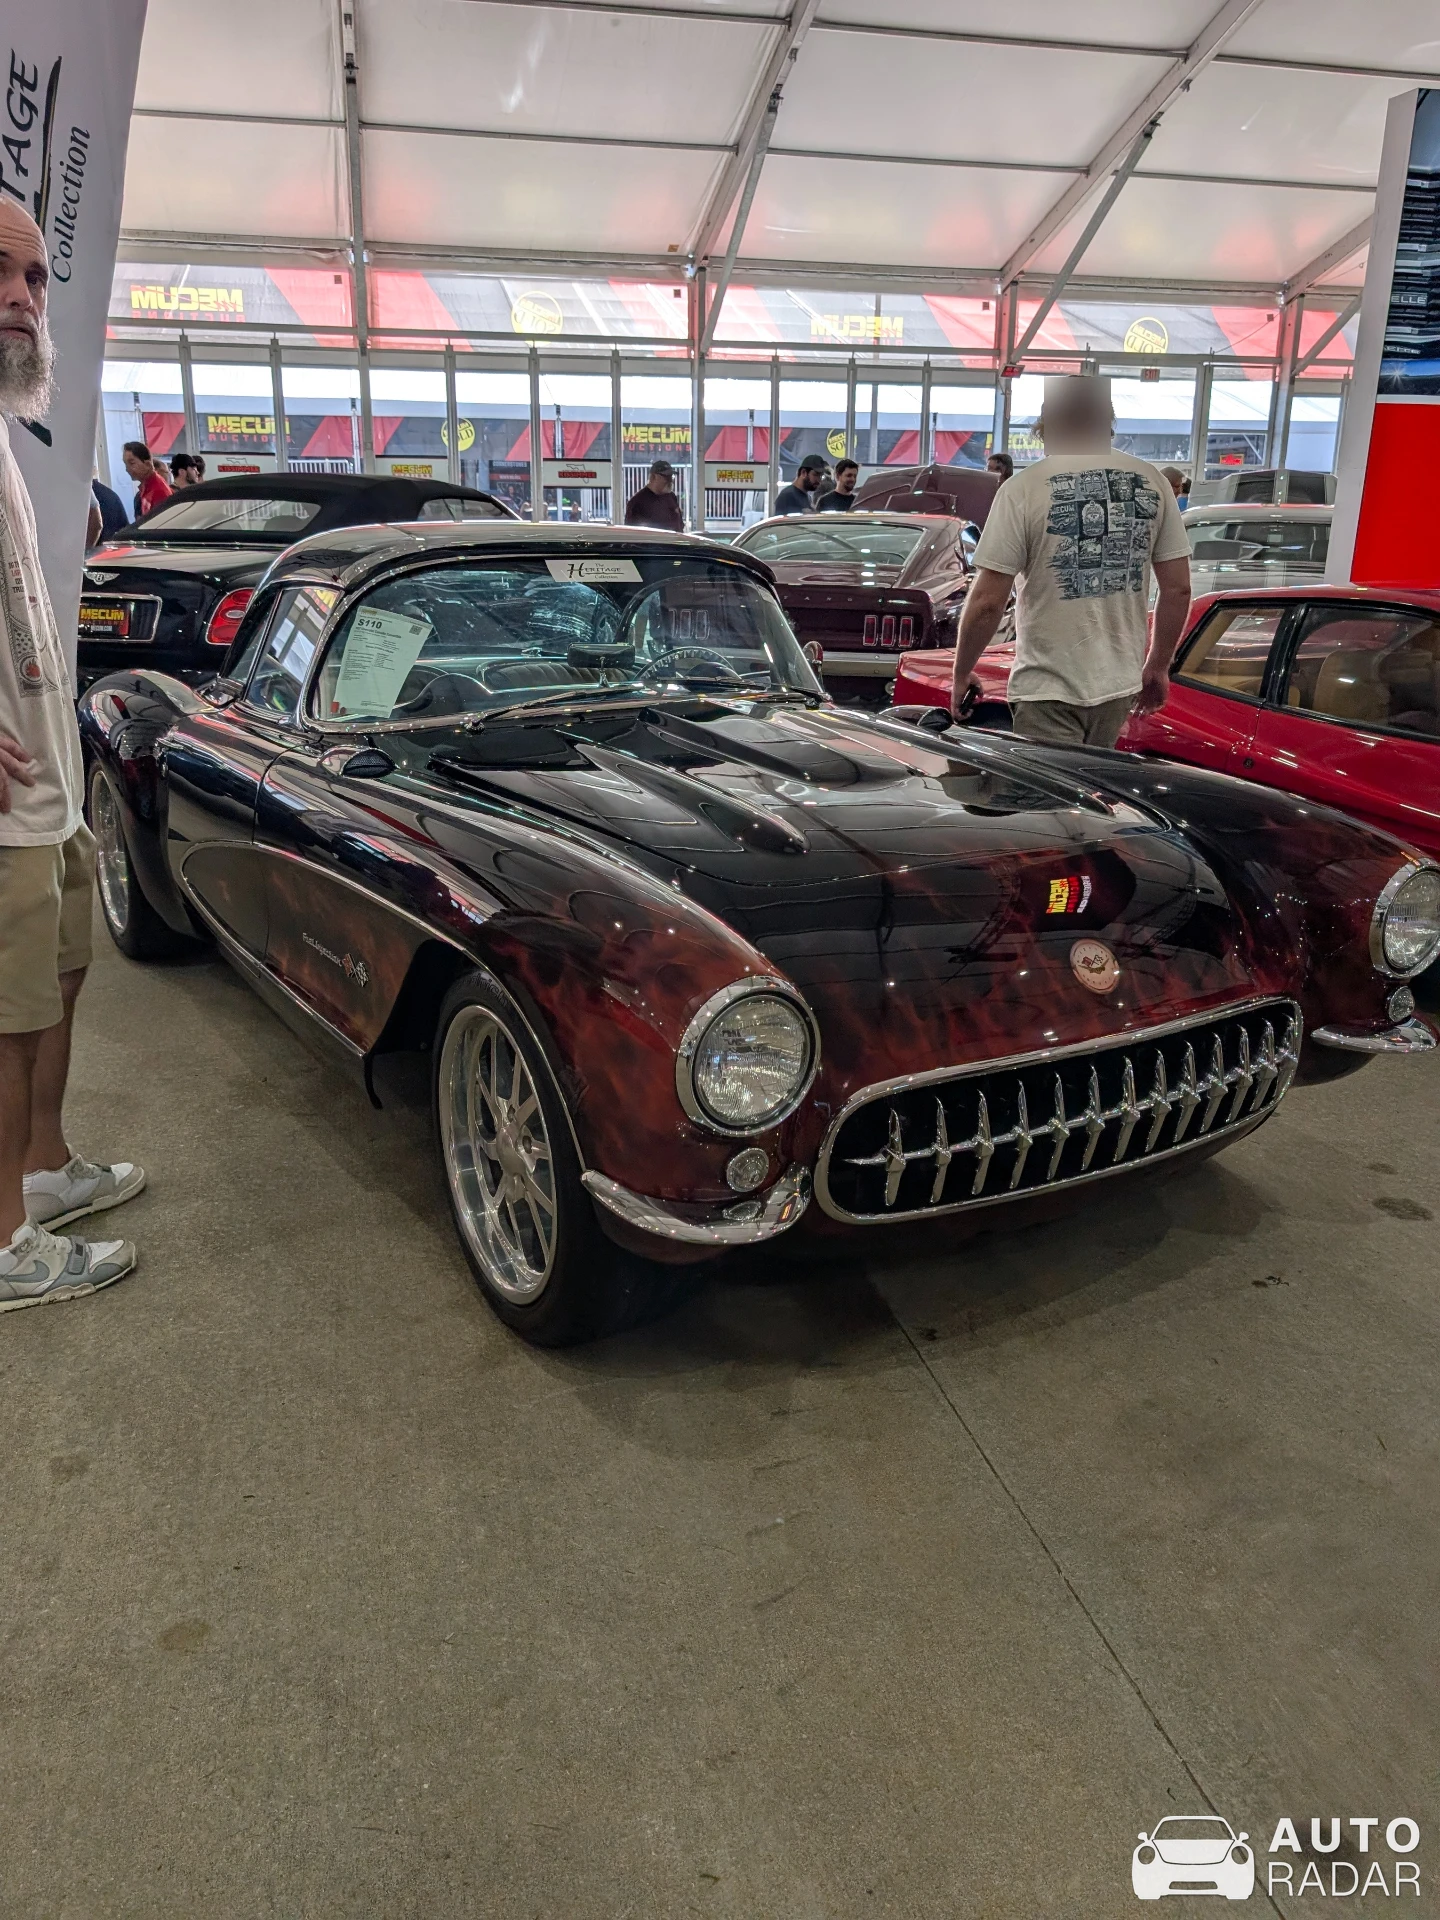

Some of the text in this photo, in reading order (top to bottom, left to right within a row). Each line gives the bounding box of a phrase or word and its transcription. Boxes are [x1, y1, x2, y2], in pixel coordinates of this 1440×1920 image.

[52, 126, 91, 283] Collection
[622, 426, 691, 443] MECUM
[392, 464, 432, 474] MECUM
[717, 469, 754, 479] MECUM
[567, 562, 621, 579] HERITAGE
[80, 608, 124, 620] MECUM
[357, 618, 382, 630] S110
